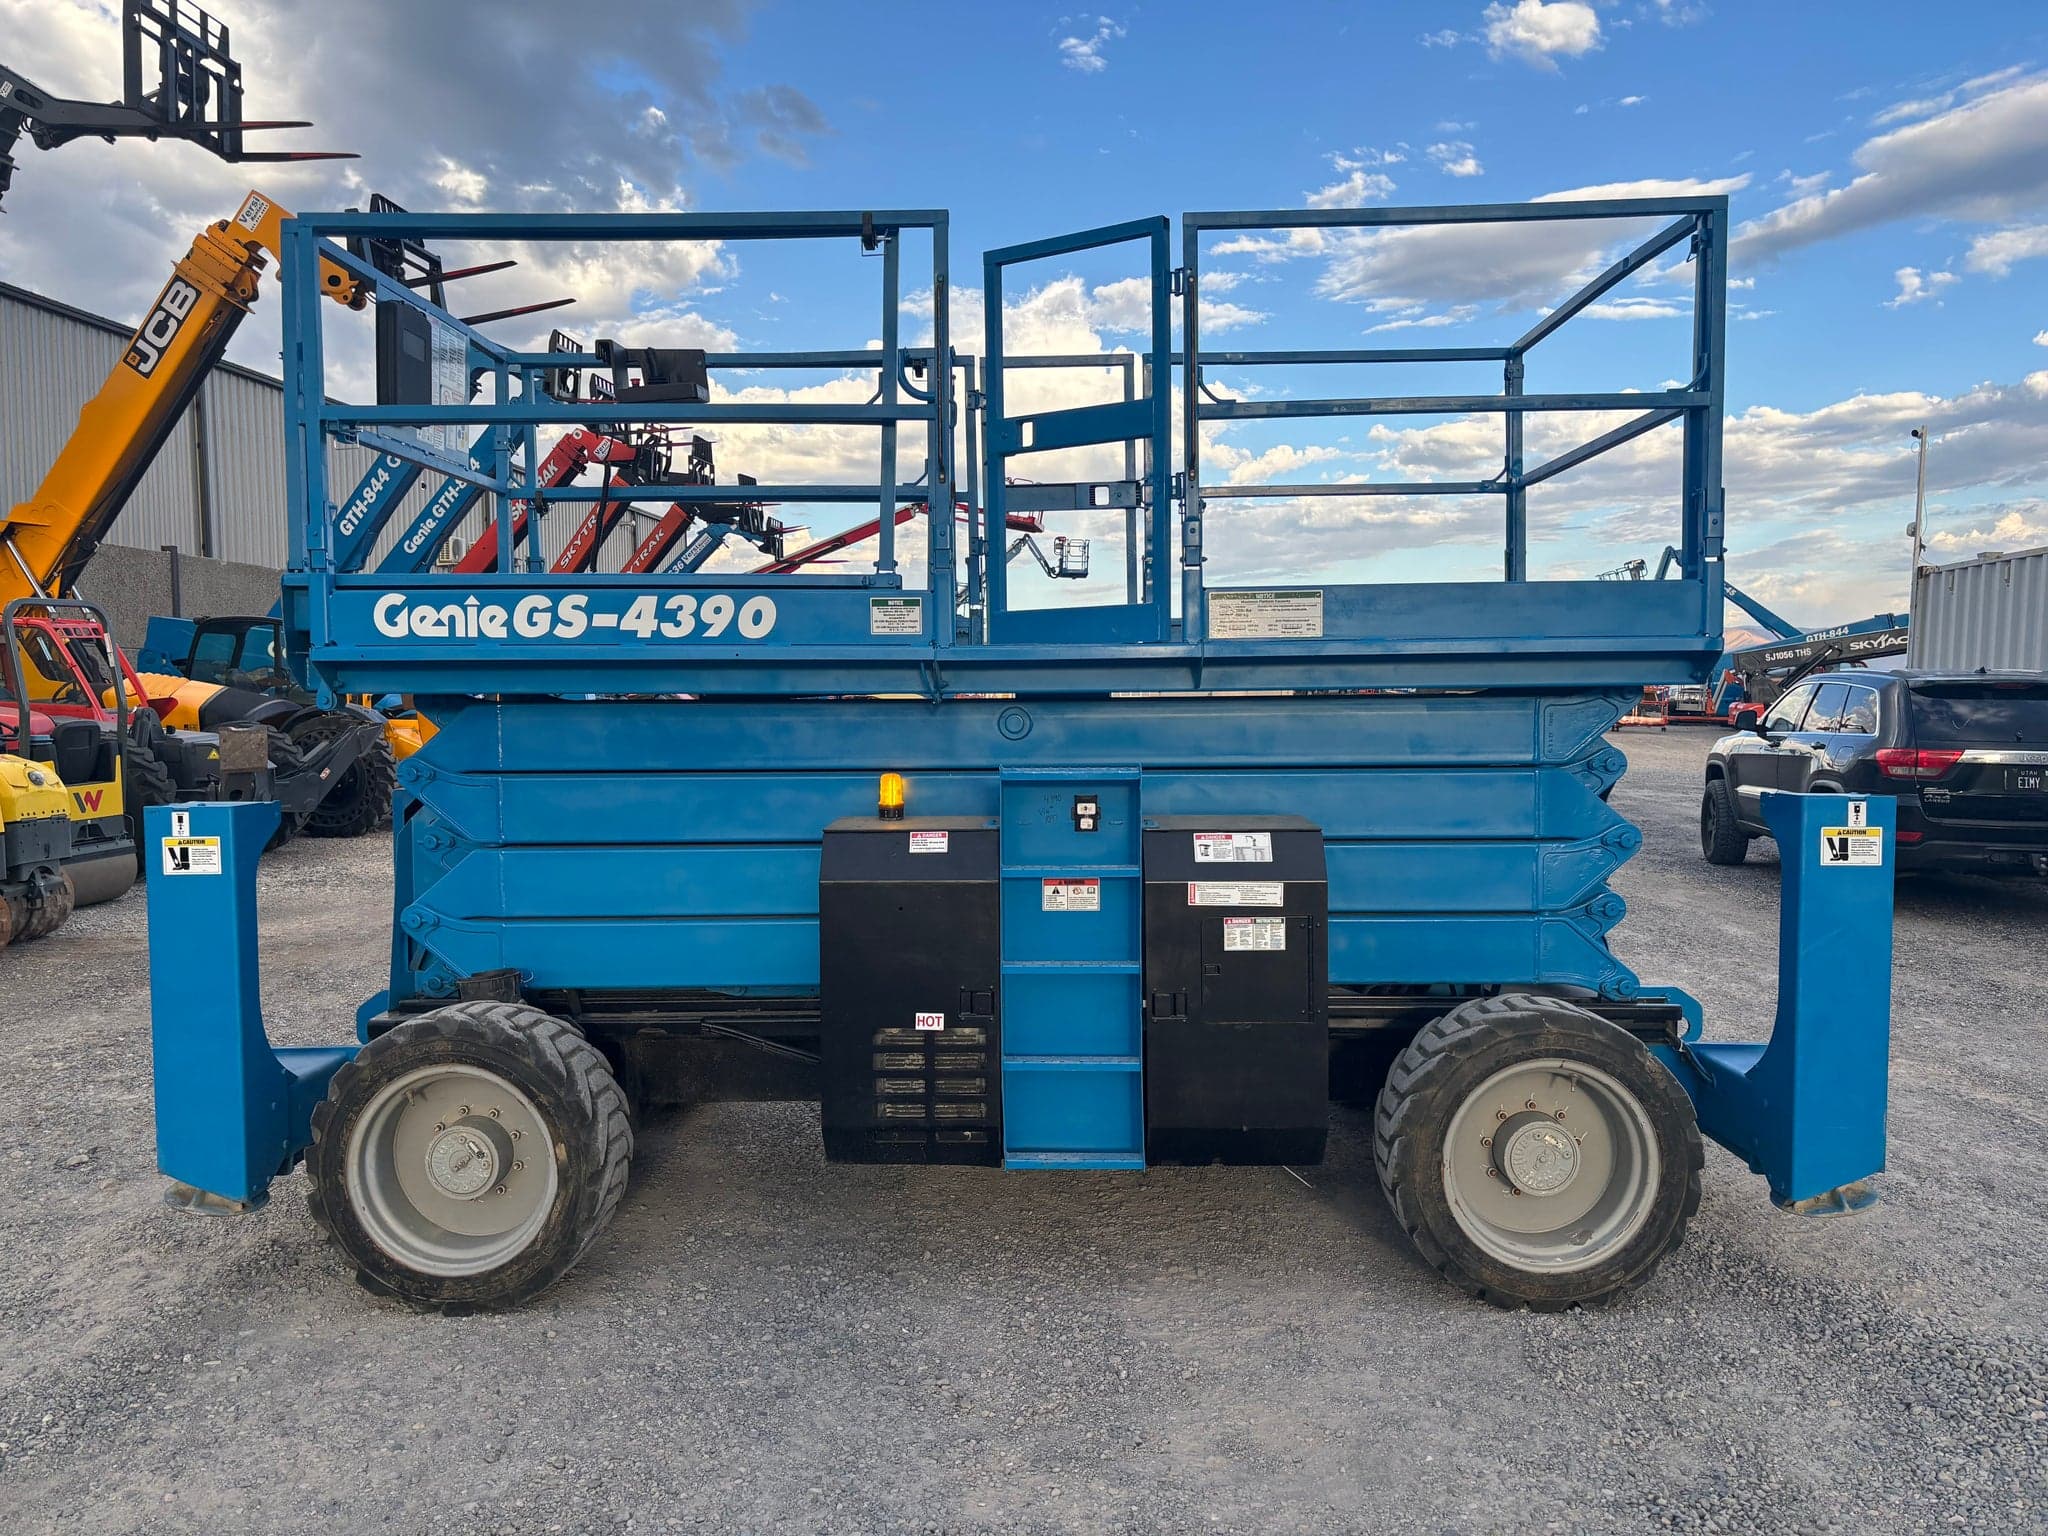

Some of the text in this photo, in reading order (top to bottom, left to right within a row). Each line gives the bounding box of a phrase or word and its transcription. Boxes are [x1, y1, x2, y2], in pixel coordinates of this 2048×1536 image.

[239, 195, 260, 223] Versi
[136, 281, 197, 373] JCB
[339, 467, 390, 537] GTH-844
[403, 520, 436, 554] Genie
[373, 593, 777, 639] Genie GS-4390
[1806, 626, 1849, 642] GTH-844
[1850, 634, 1909, 650] SKYJAC
[1765, 648, 1812, 662] SJ1056 THS
[917, 1015, 943, 1028] HOT
